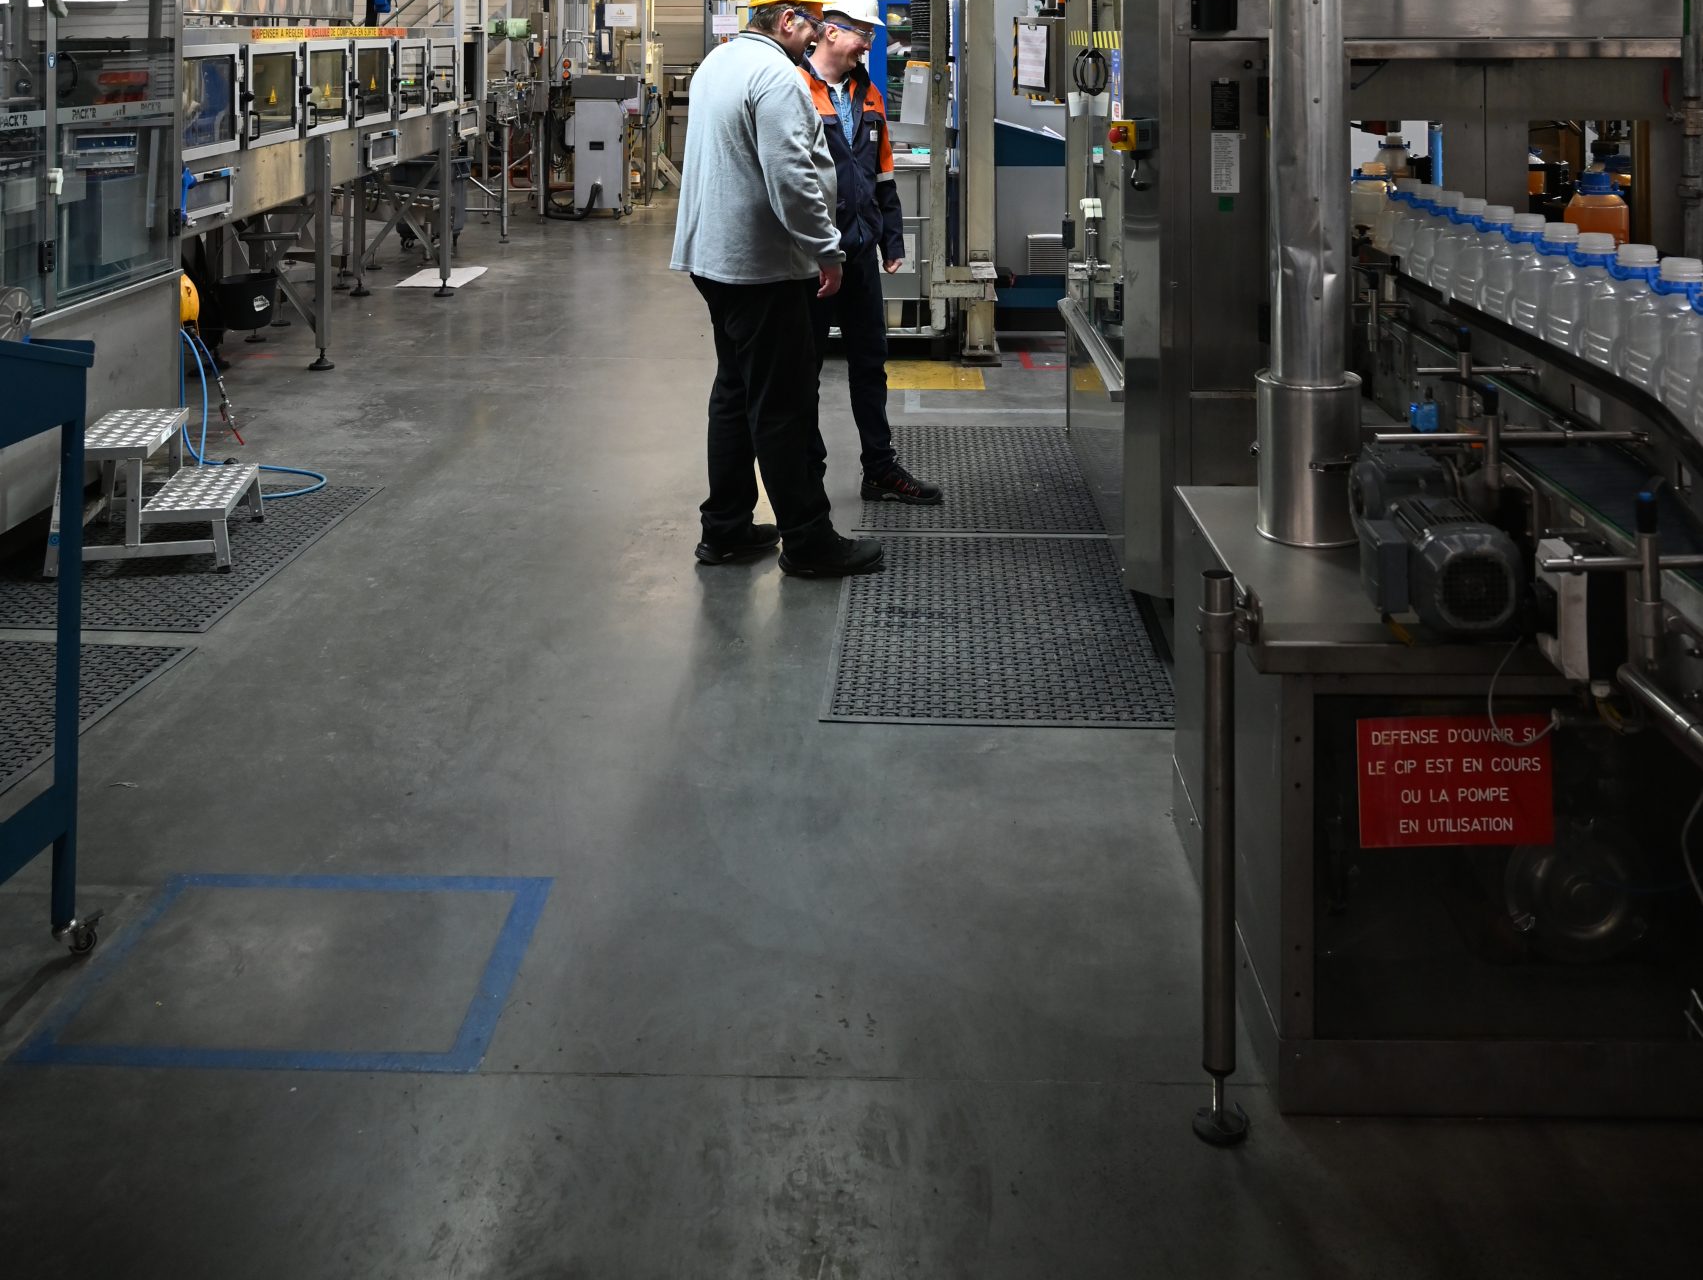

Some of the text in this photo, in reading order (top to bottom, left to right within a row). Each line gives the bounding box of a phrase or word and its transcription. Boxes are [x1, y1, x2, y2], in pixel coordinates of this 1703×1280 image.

[72, 107, 97, 121] PACK'R
[1371, 727, 1537, 746] DEFENSE D'OUVRIR SI
[1368, 757, 1541, 776] LE CIP EST EN COURS
[1400, 787, 1510, 804] OU LA POMPE
[1399, 816, 1513, 834] EN UTILISATION
